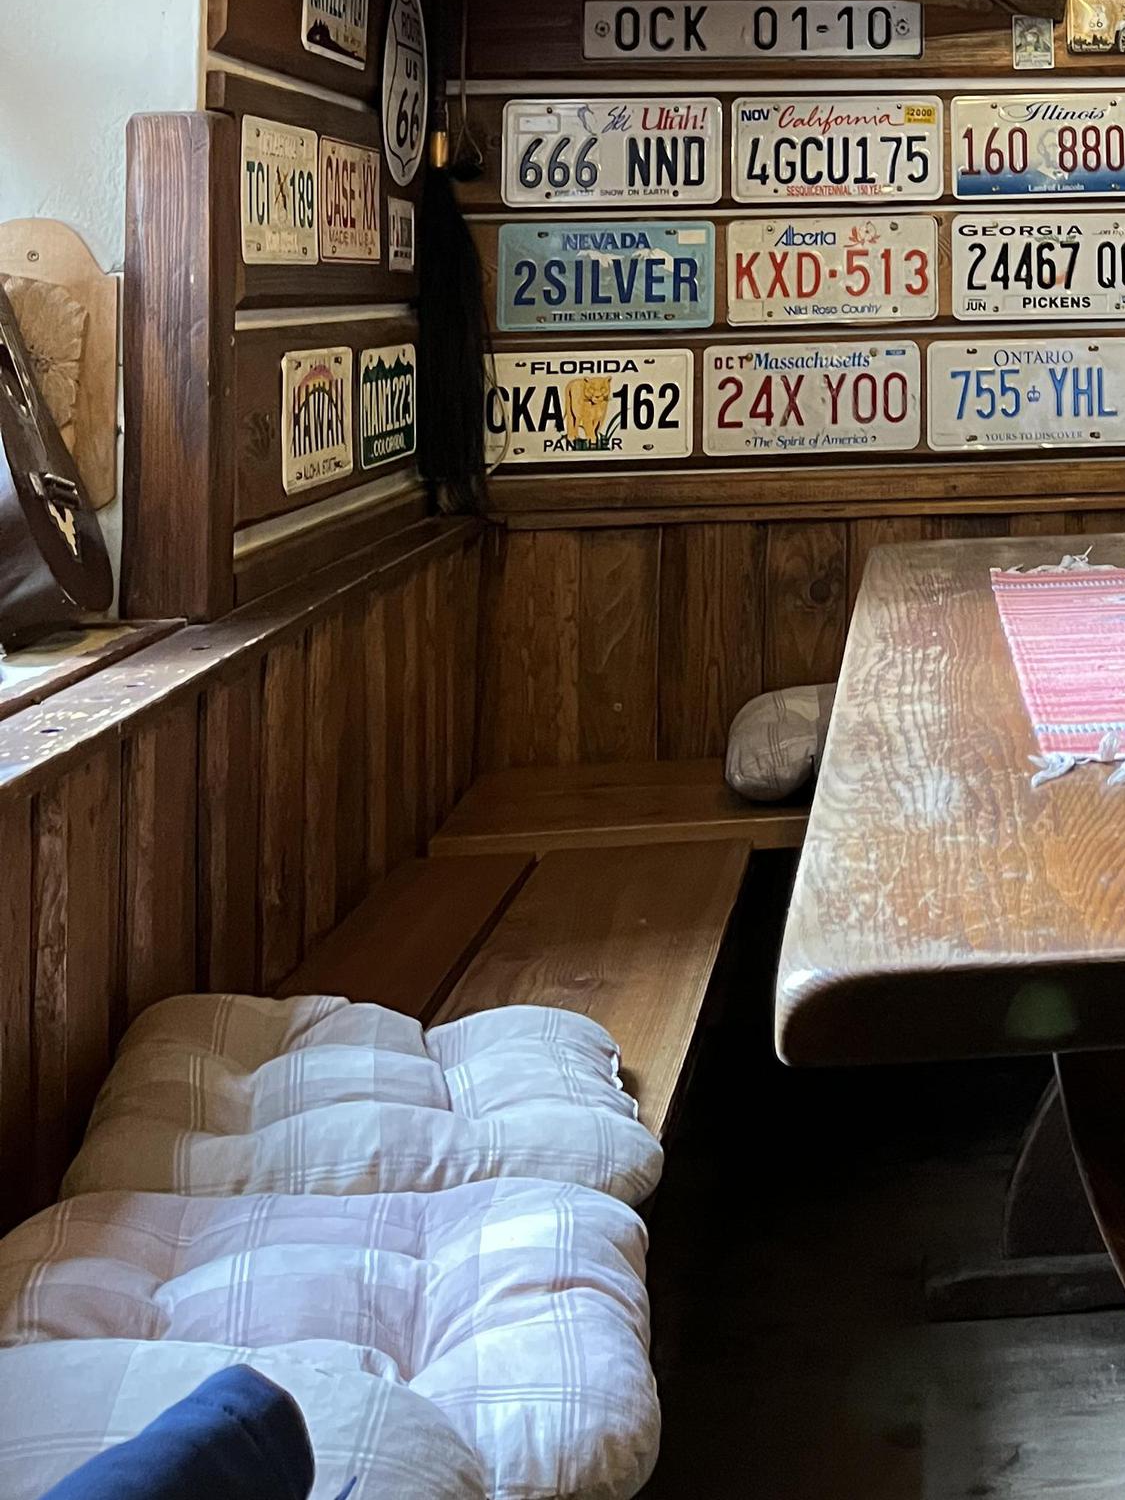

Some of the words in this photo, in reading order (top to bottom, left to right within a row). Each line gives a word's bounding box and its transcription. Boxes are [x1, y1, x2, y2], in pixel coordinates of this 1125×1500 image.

[405, 57, 419, 82] US
[396, 88, 420, 151] 66
[740, 107, 771, 123] NOV
[778, 105, 903, 137] California
[960, 124, 1029, 176] 160
[518, 136, 599, 190] 666
[627, 135, 706, 188] NND
[746, 135, 930, 186] 4GCU175
[246, 160, 270, 228] TCI
[290, 167, 314, 230] 189
[326, 154, 356, 230] CASE
[773, 225, 837, 249] Alberta
[958, 223, 1084, 237] GEORGIA
[561, 231, 651, 252] NEVADA
[966, 241, 1081, 291] 24467
[512, 257, 700, 307] 2SILVER
[783, 303, 810, 317] Wild
[812, 303, 839, 316] Rose
[841, 302, 883, 317] Country
[965, 299, 987, 312] JUN
[1021, 296, 1092, 310] PICKENS
[552, 312, 575, 323] THE
[578, 311, 623, 323] SILVER
[625, 310, 661, 322] STATE
[530, 359, 640, 376] FLORIDA
[713, 356, 748, 371] OCT
[753, 350, 871, 370] Massachusetts
[993, 348, 1074, 368] ONTARIO
[949, 368, 1022, 421] 755
[1047, 366, 1119, 418] YHL
[543, 437, 624, 453] PANTHER
[752, 435, 775, 447] The
[776, 434, 807, 449] Spirit
[808, 433, 819, 448] of
[822, 433, 868, 446] America
[985, 432, 1018, 442] YOURS
[1019, 432, 1032, 441] TO
[1034, 430, 1084, 441] DISCOVER
